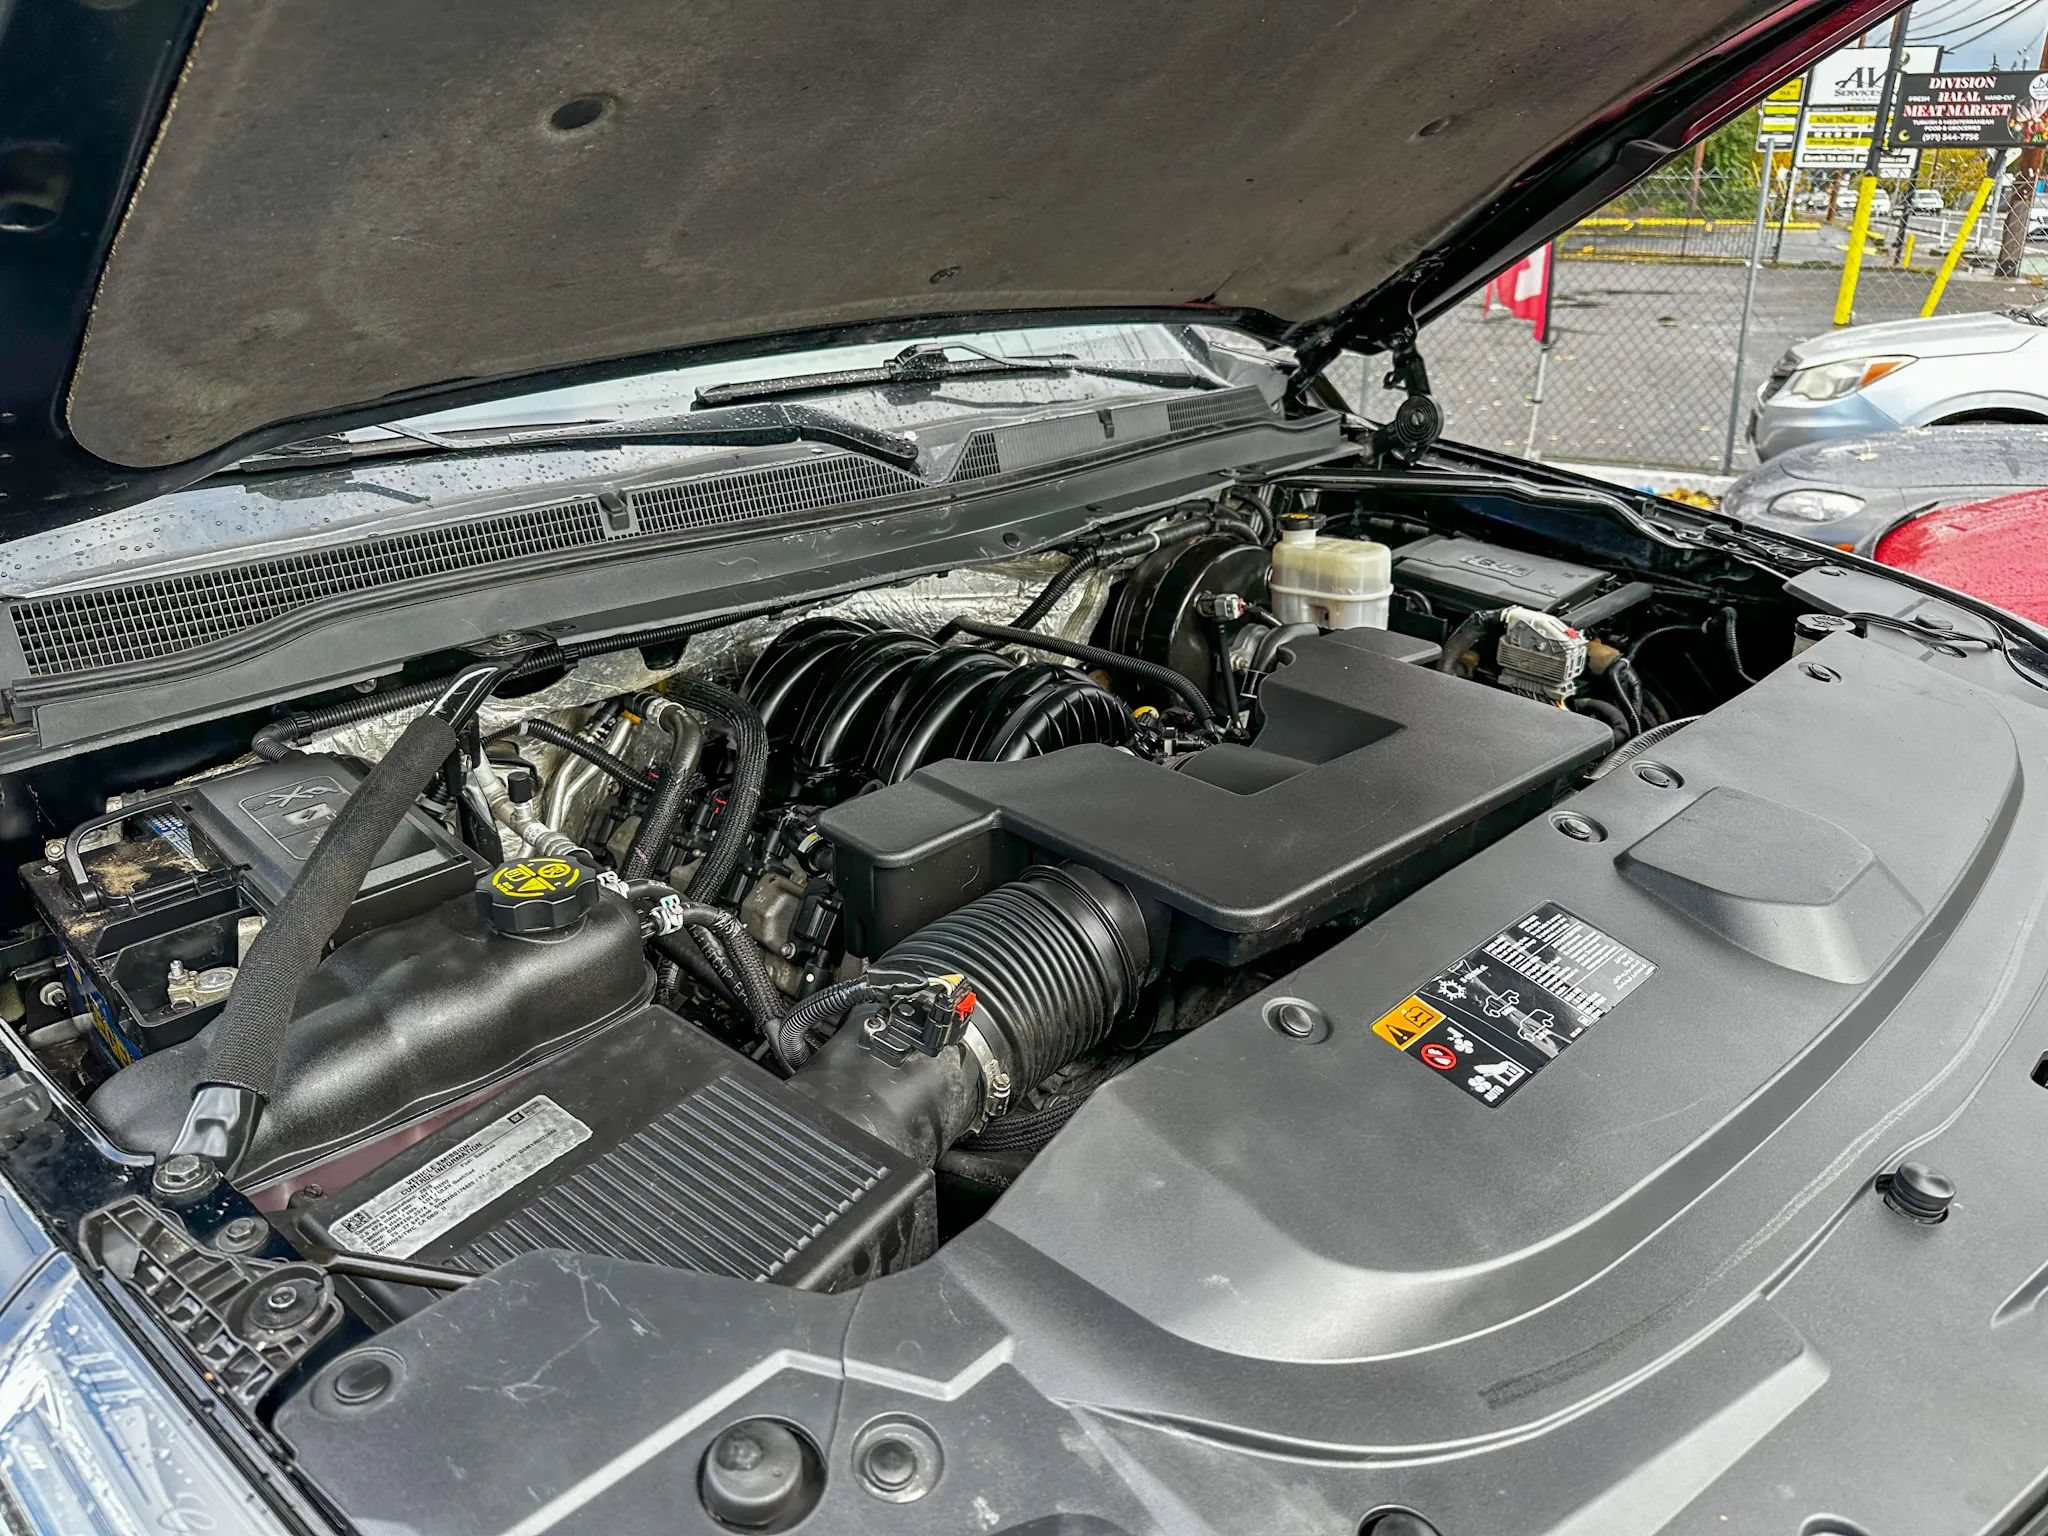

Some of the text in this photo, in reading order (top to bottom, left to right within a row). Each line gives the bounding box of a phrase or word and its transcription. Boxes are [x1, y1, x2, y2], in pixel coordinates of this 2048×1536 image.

[1929, 75, 1997, 89] DIVISION
[1937, 91, 1981, 103] HALAL
[1903, 103, 2013, 118] MEAT MARKET
[1922, 133, 1942, 143] (971)
[399, 1142, 483, 1195] CONTROL INFORMATION
[405, 1143, 470, 1185] VEHICLE EMISSION
